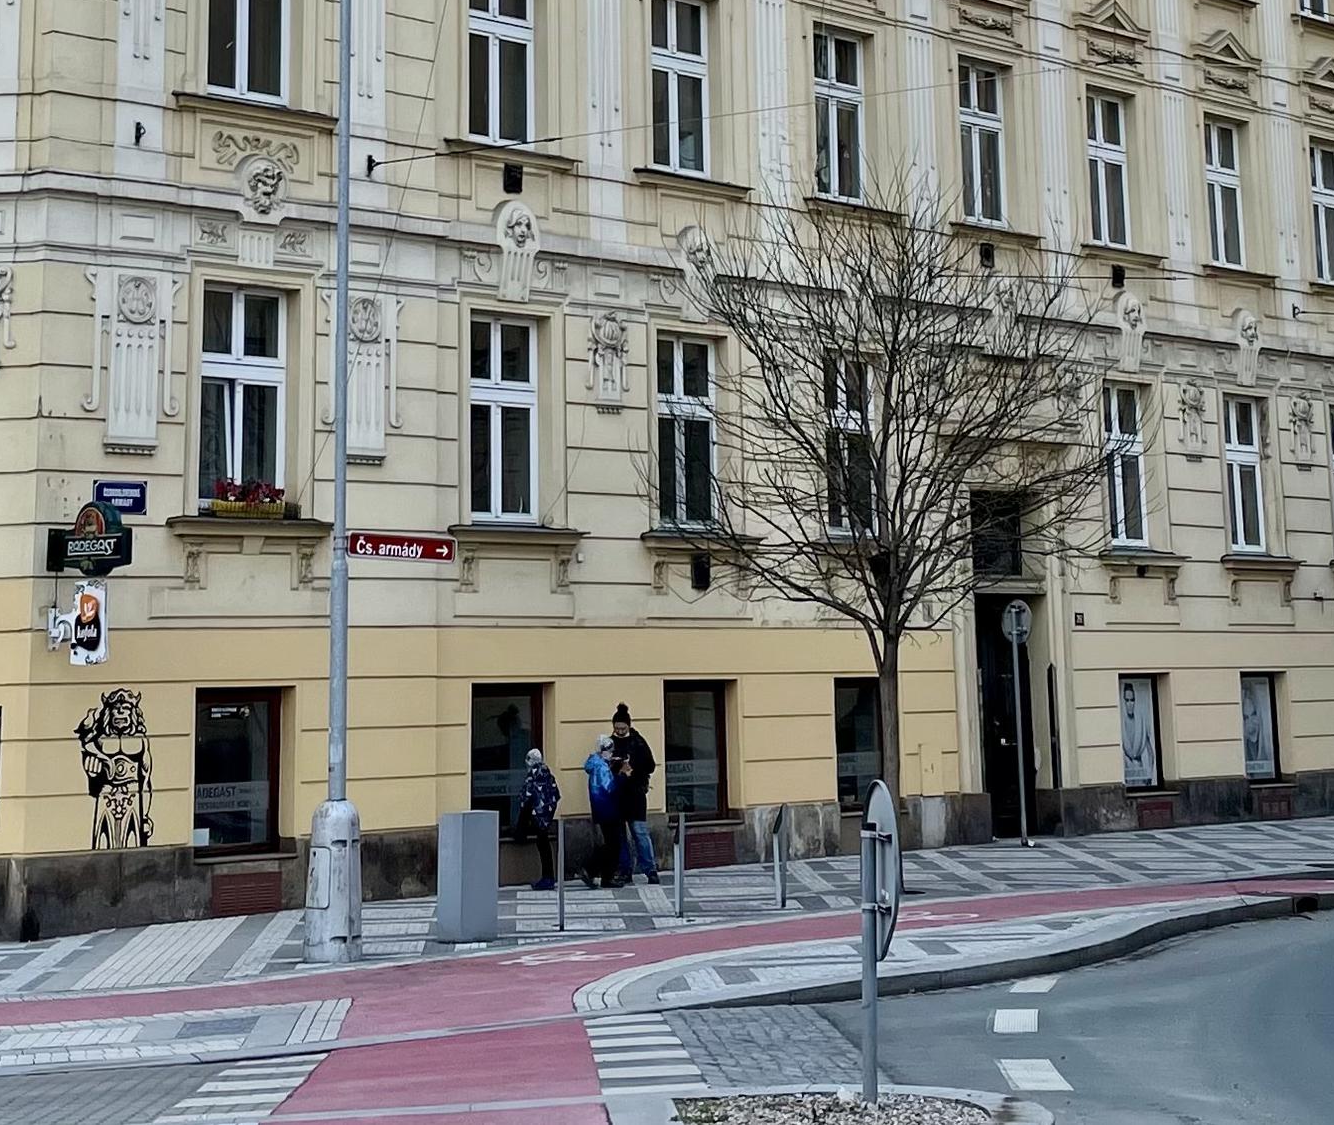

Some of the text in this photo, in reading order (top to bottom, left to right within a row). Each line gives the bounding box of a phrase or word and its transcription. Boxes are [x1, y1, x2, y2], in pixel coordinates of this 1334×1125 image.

[67, 539, 117, 556] RADEGAST
[356, 536, 424, 559] Čs. armády
[197, 785, 237, 799] ADEGAST
